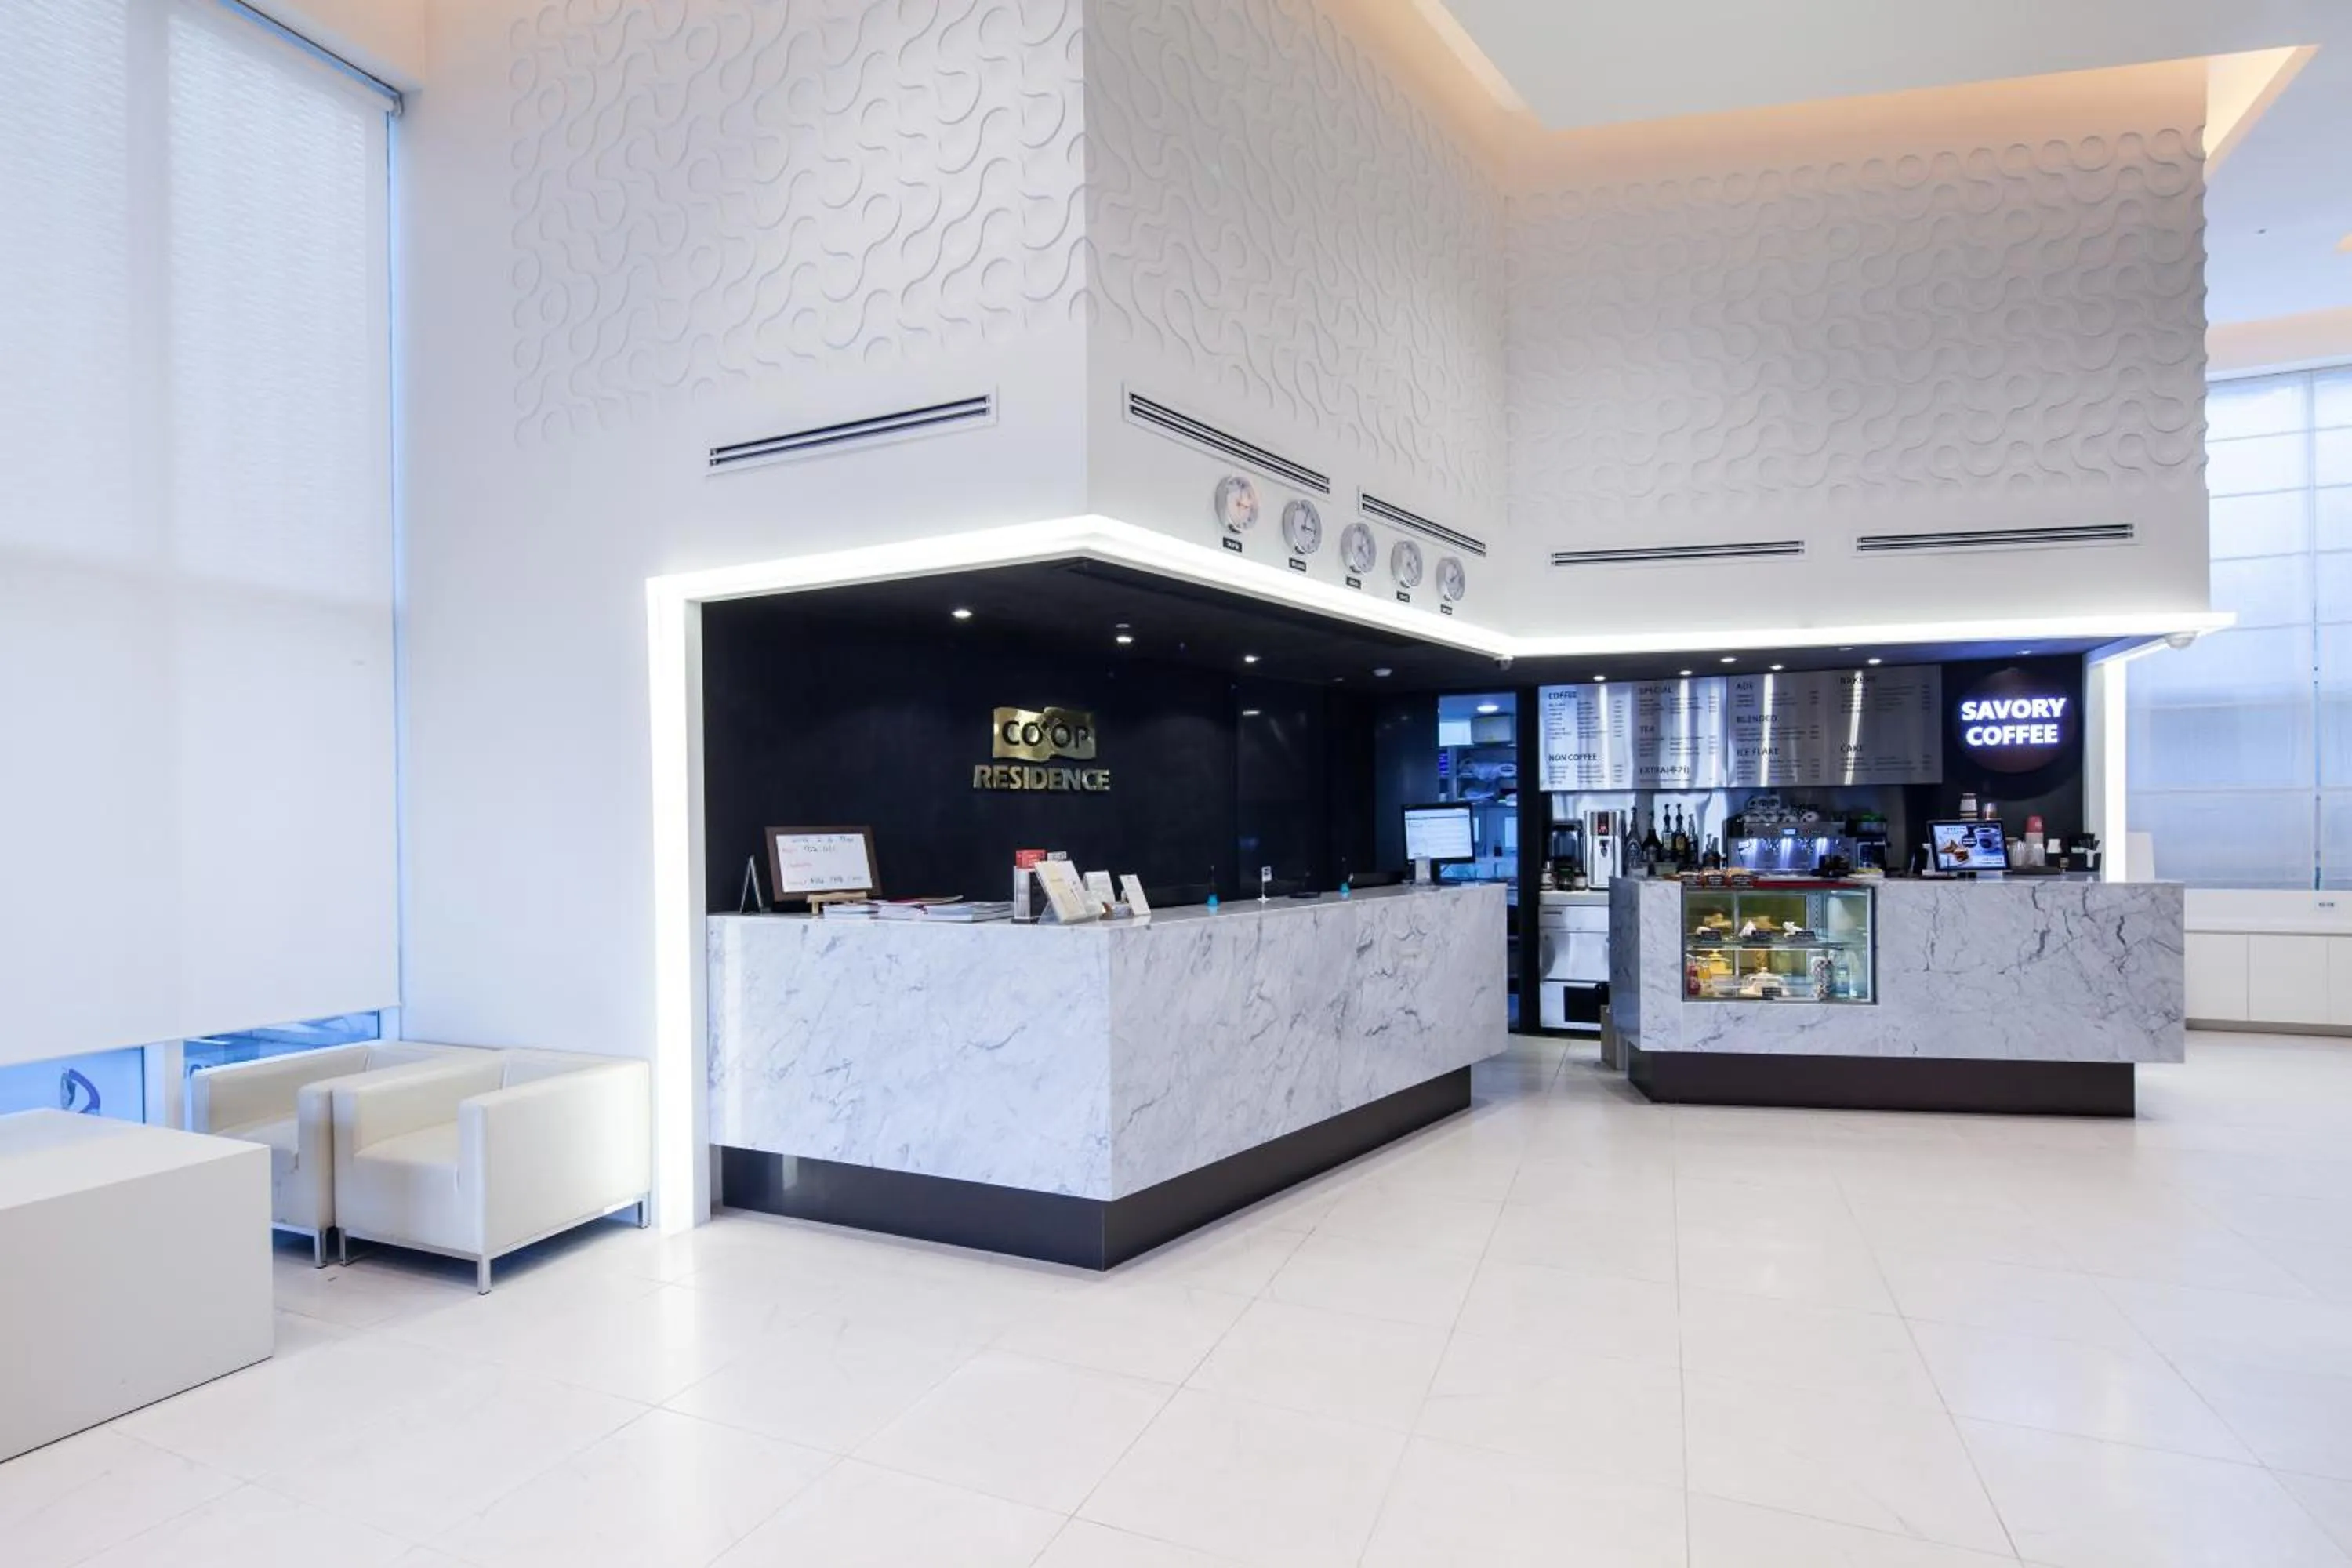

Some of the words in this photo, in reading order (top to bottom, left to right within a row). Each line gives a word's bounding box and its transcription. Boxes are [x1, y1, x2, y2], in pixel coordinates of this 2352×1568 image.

[1548, 691, 1577, 700] COFFEE
[1961, 697, 2067, 720] SAVORY
[1965, 724, 2058, 746] COFFEE
[1568, 753, 1598, 761] COFFEE
[973, 764, 1112, 791] RESIDENCE
